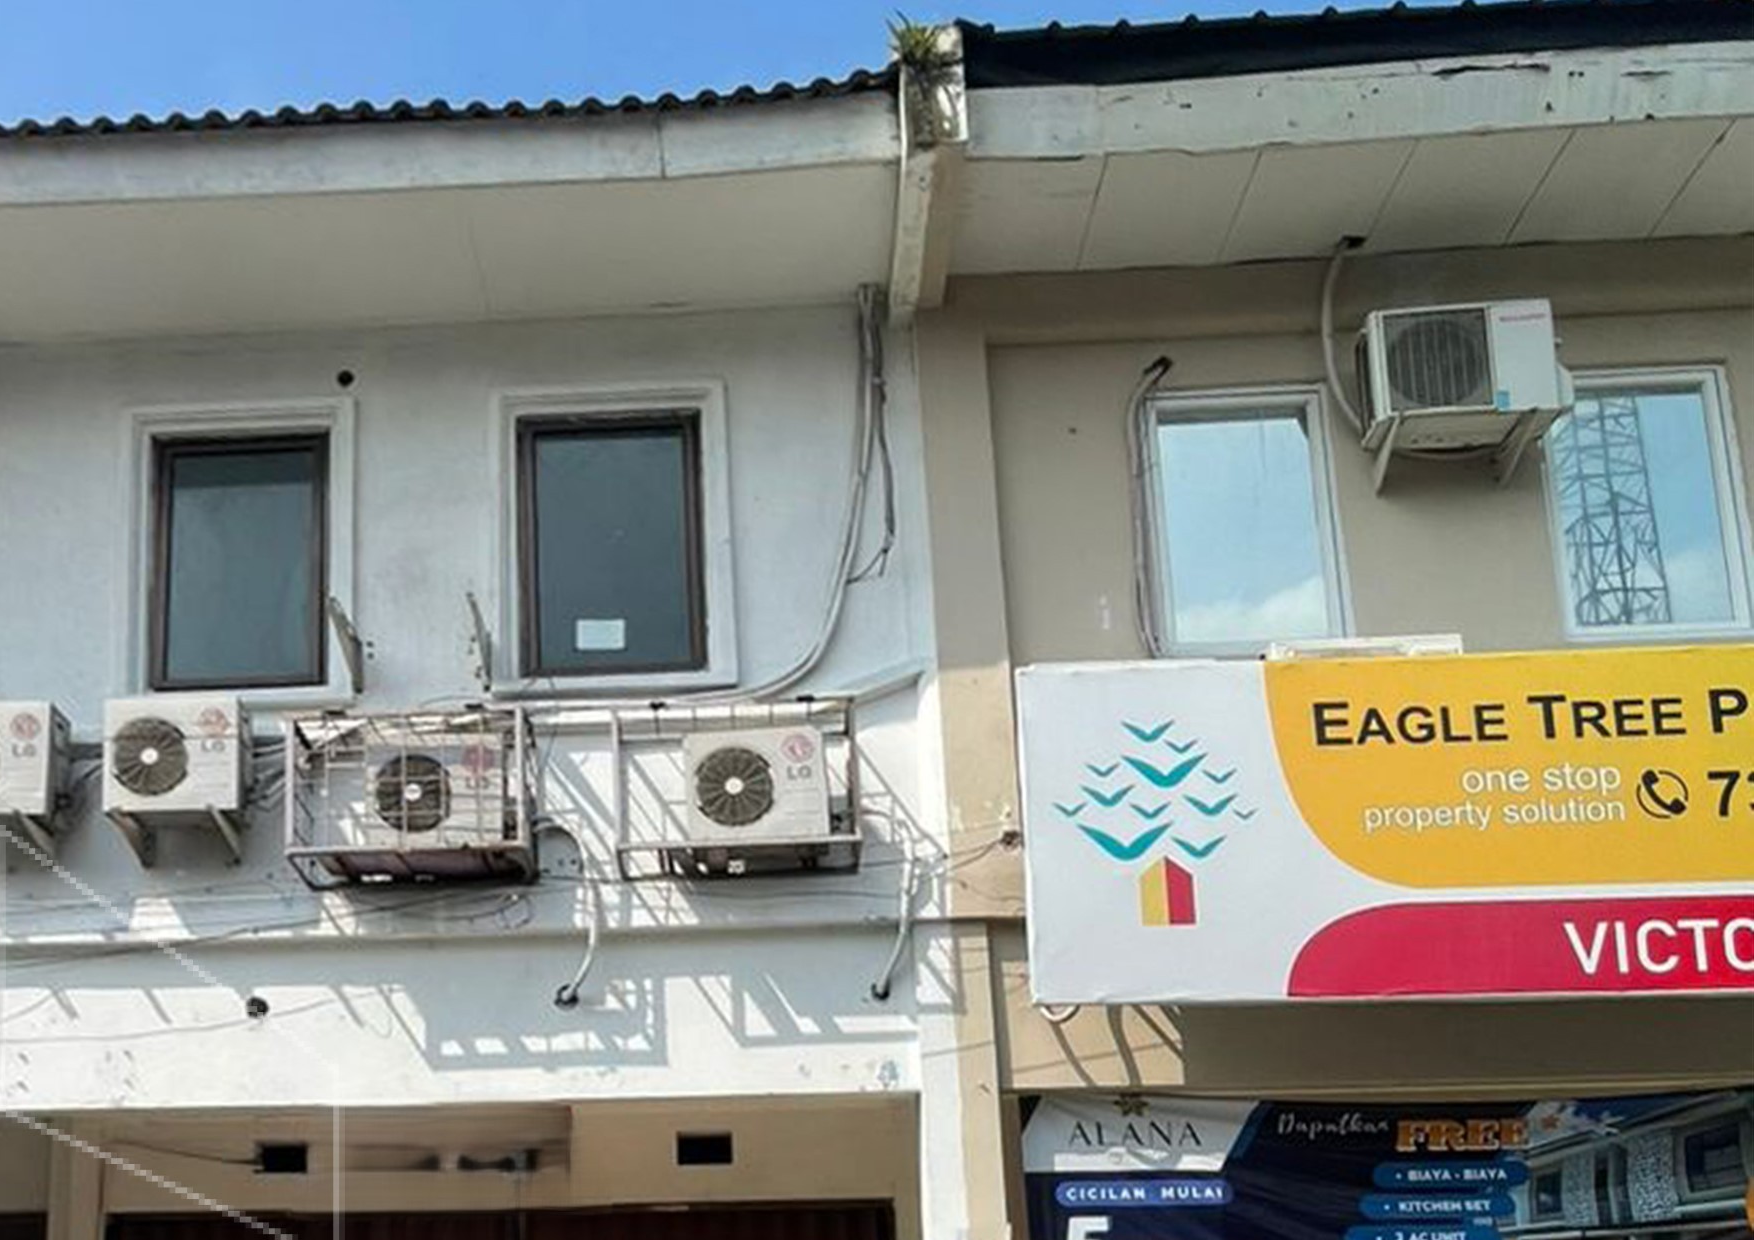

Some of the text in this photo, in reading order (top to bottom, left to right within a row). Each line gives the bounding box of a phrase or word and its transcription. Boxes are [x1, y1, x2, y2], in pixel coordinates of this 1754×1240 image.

[1312, 701, 1509, 746] EAGLE
[1527, 694, 1687, 739] TREE
[1462, 763, 1621, 794] one stop
[1706, 770, 1754, 817] 7
[1364, 797, 1626, 831] property solution
[1069, 1120, 1203, 1146] ALANA
[1396, 1118, 1528, 1152] FREE
[1407, 1170, 1452, 1181] BIAYA
[1463, 1169, 1508, 1180] BIAYA
[1065, 1186, 1224, 1201] CICILAN MULAI
[1398, 1200, 1492, 1212] KITCHEN SET
